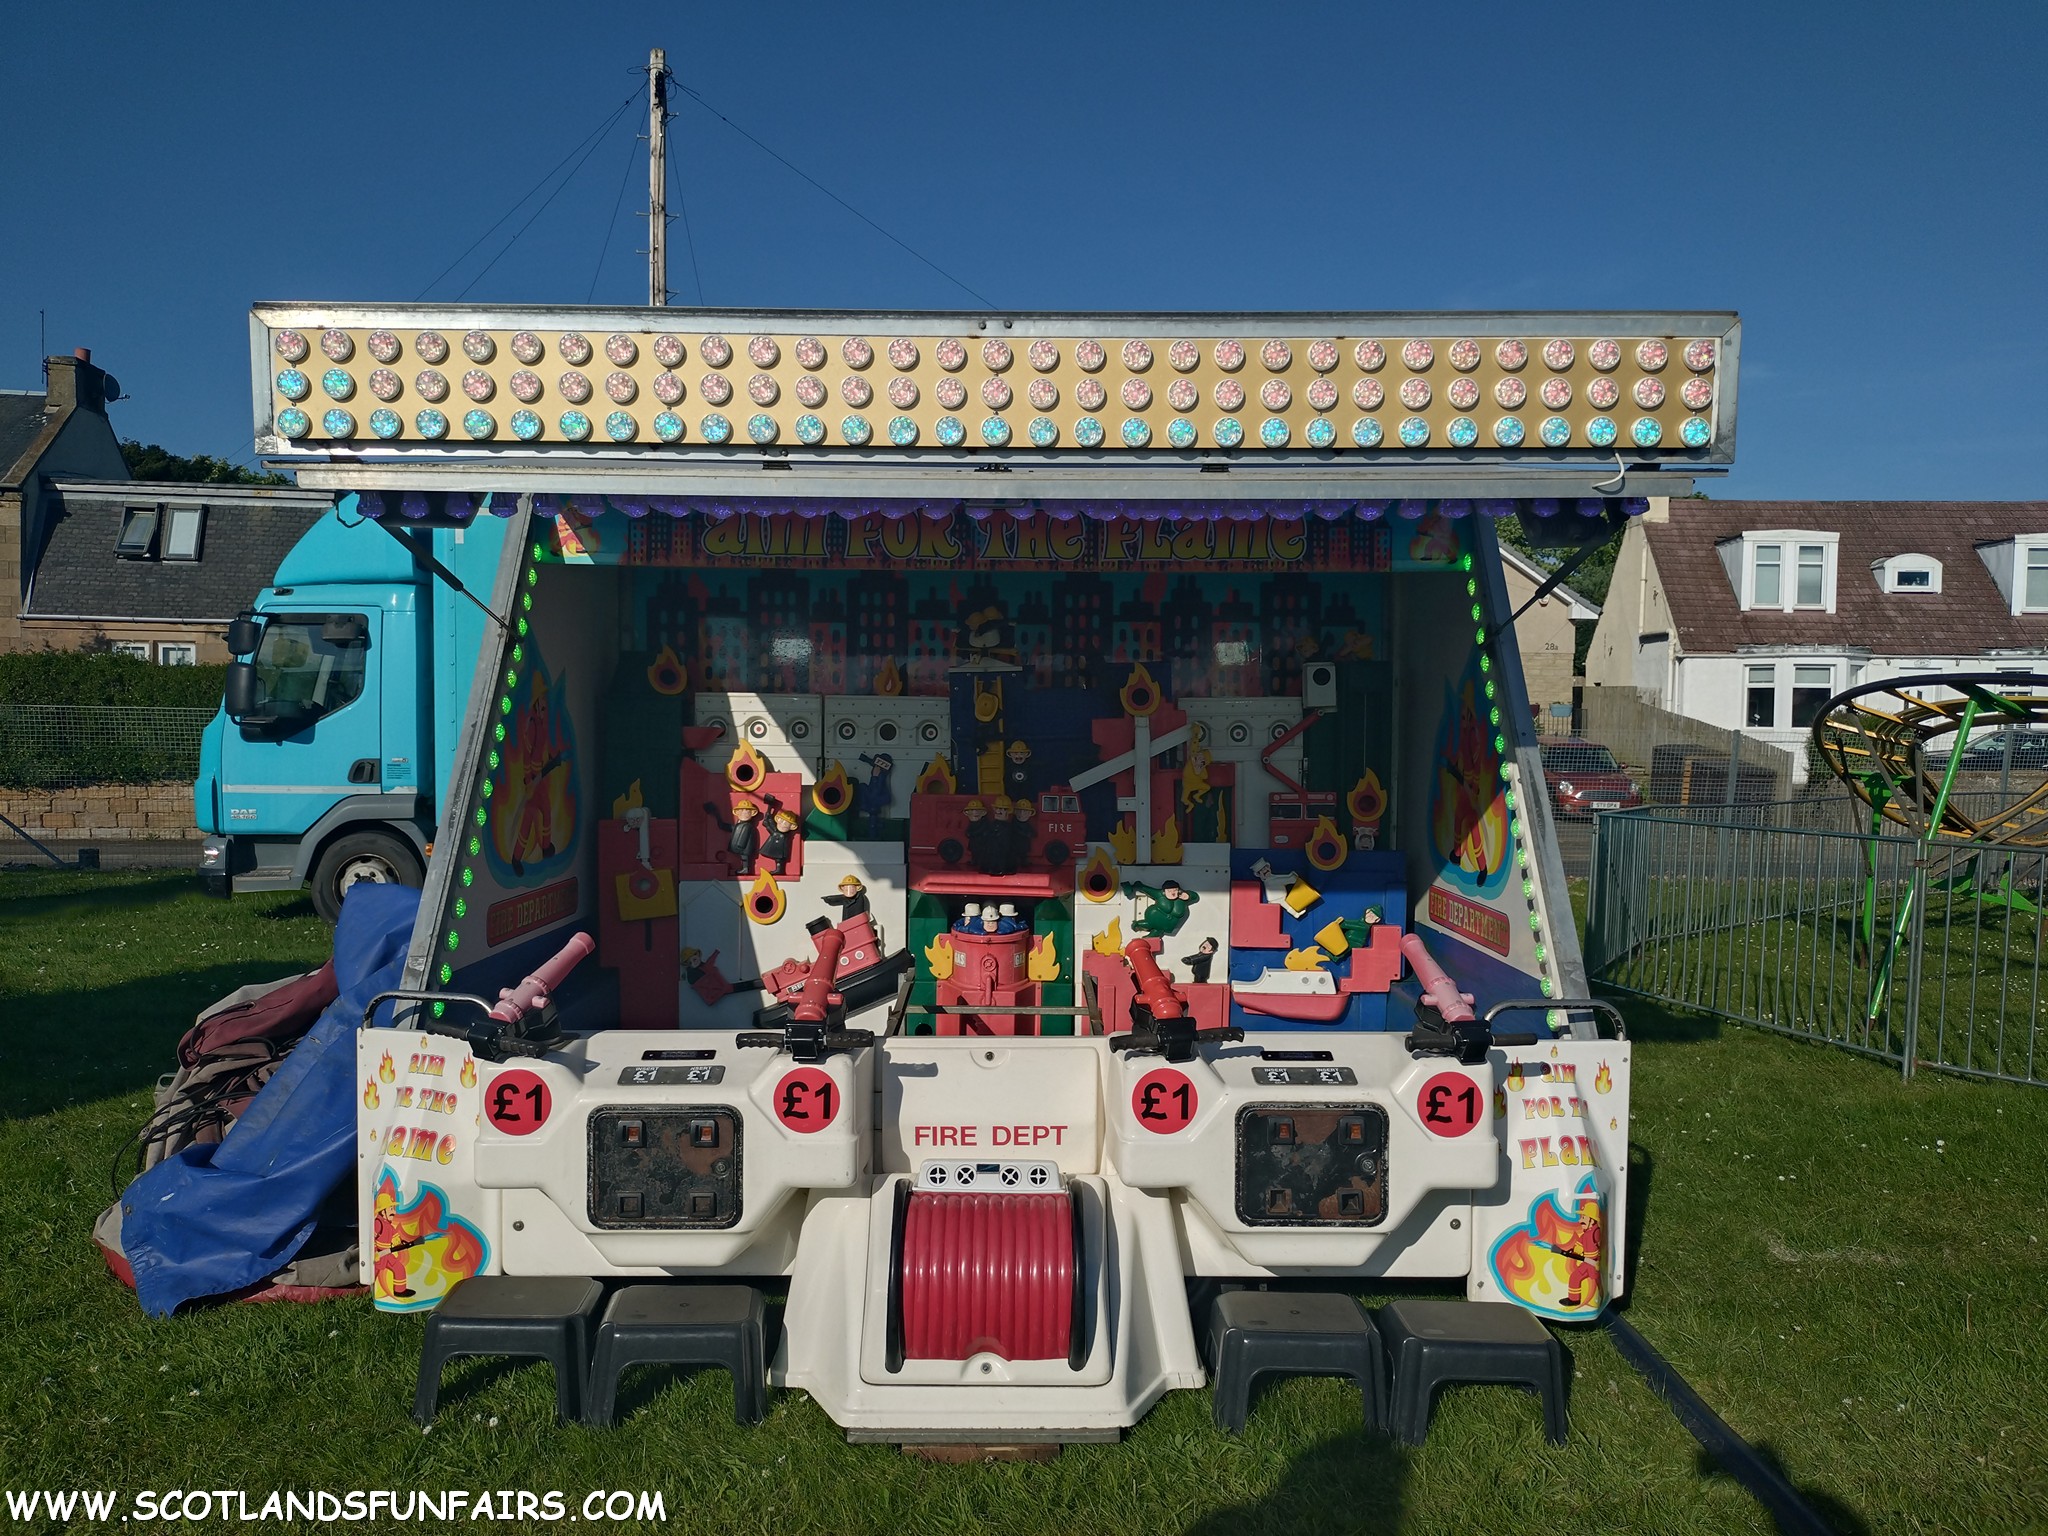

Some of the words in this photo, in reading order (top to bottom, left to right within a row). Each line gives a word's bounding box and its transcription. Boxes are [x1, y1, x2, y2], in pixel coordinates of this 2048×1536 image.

[844, 507, 963, 560] FOR
[1048, 823, 1072, 833] FIRE
[516, 885, 578, 929] DEPARTM
[1430, 892, 1447, 921] FIRE
[1448, 899, 1507, 949] DEPARTMENT
[633, 1070, 657, 1081] £1
[686, 1069, 711, 1081] £1
[1267, 1071, 1290, 1082] £1
[1319, 1071, 1343, 1082] £1
[494, 1083, 543, 1122] £1
[782, 1081, 832, 1120] £1
[1140, 1082, 1189, 1120] £1
[1426, 1085, 1475, 1124] £1
[1522, 1096, 1565, 1120] FOR
[915, 1125, 977, 1146] FIRE
[992, 1125, 1068, 1146] DEPT
